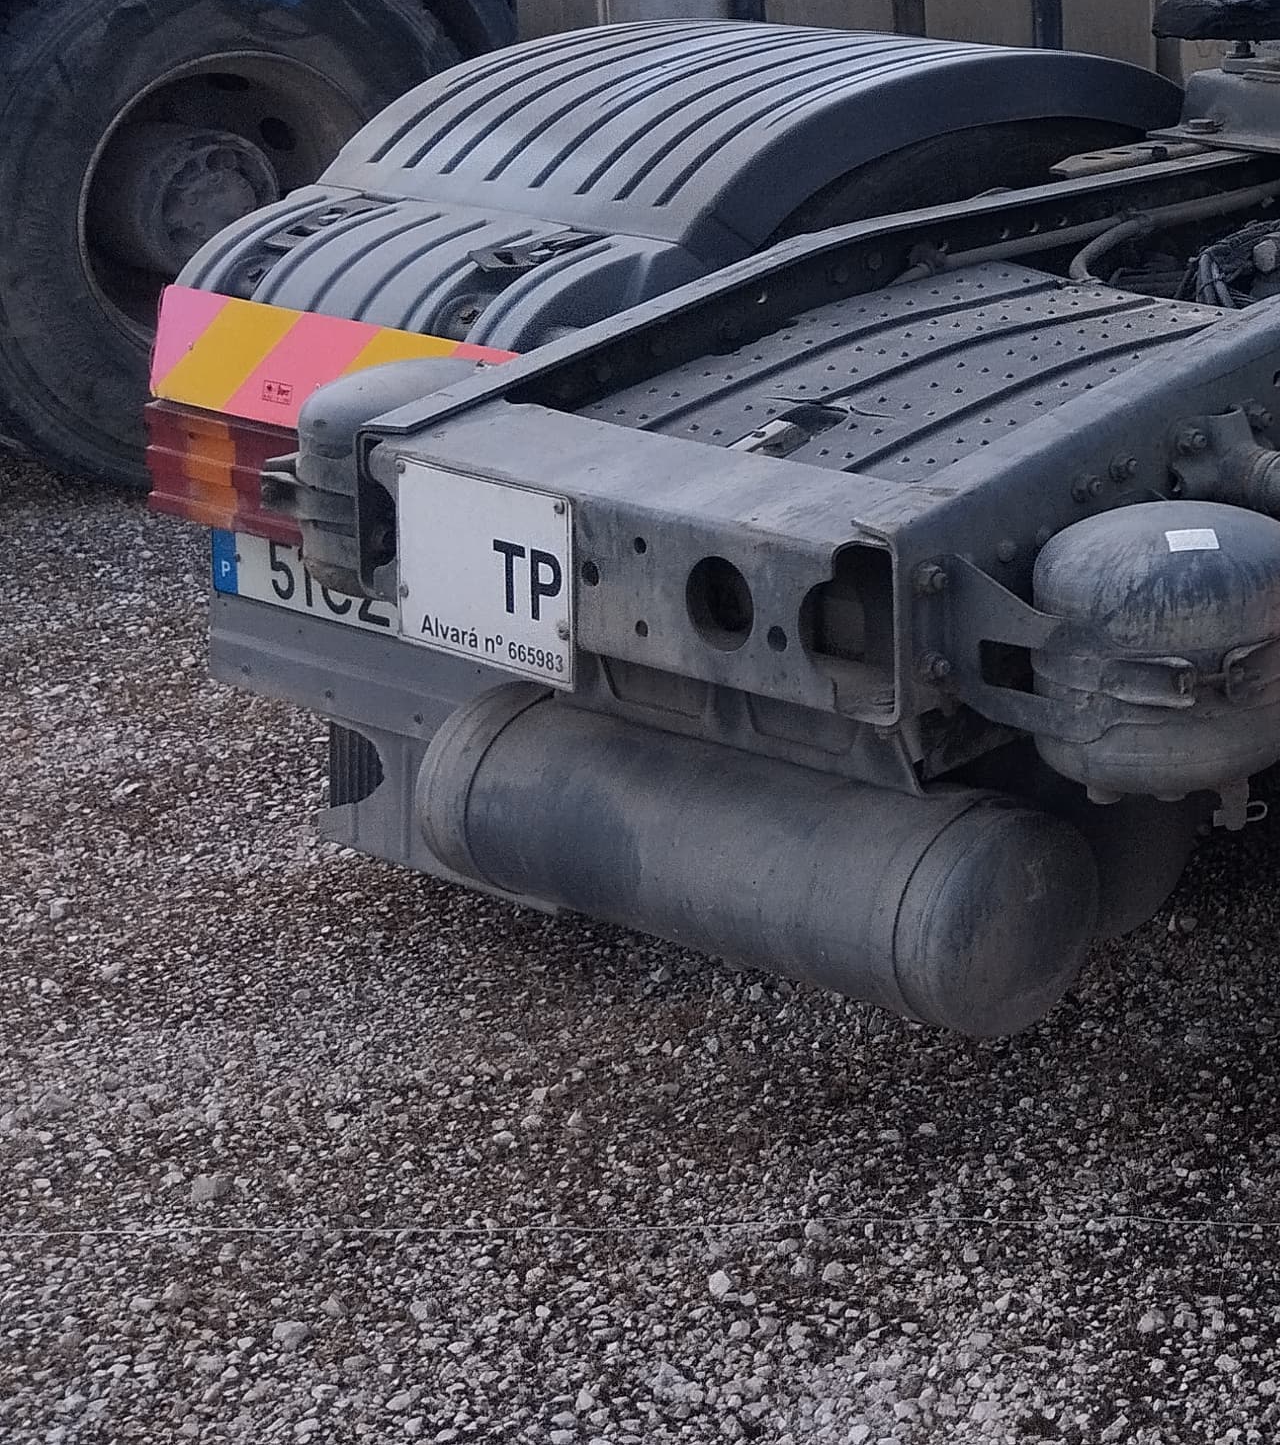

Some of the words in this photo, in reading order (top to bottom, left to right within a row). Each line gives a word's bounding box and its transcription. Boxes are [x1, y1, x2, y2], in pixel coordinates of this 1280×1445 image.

[220, 559, 232, 578] P
[492, 538, 563, 622] TP
[421, 614, 479, 650] Alvará
[508, 641, 564, 674] 665983
